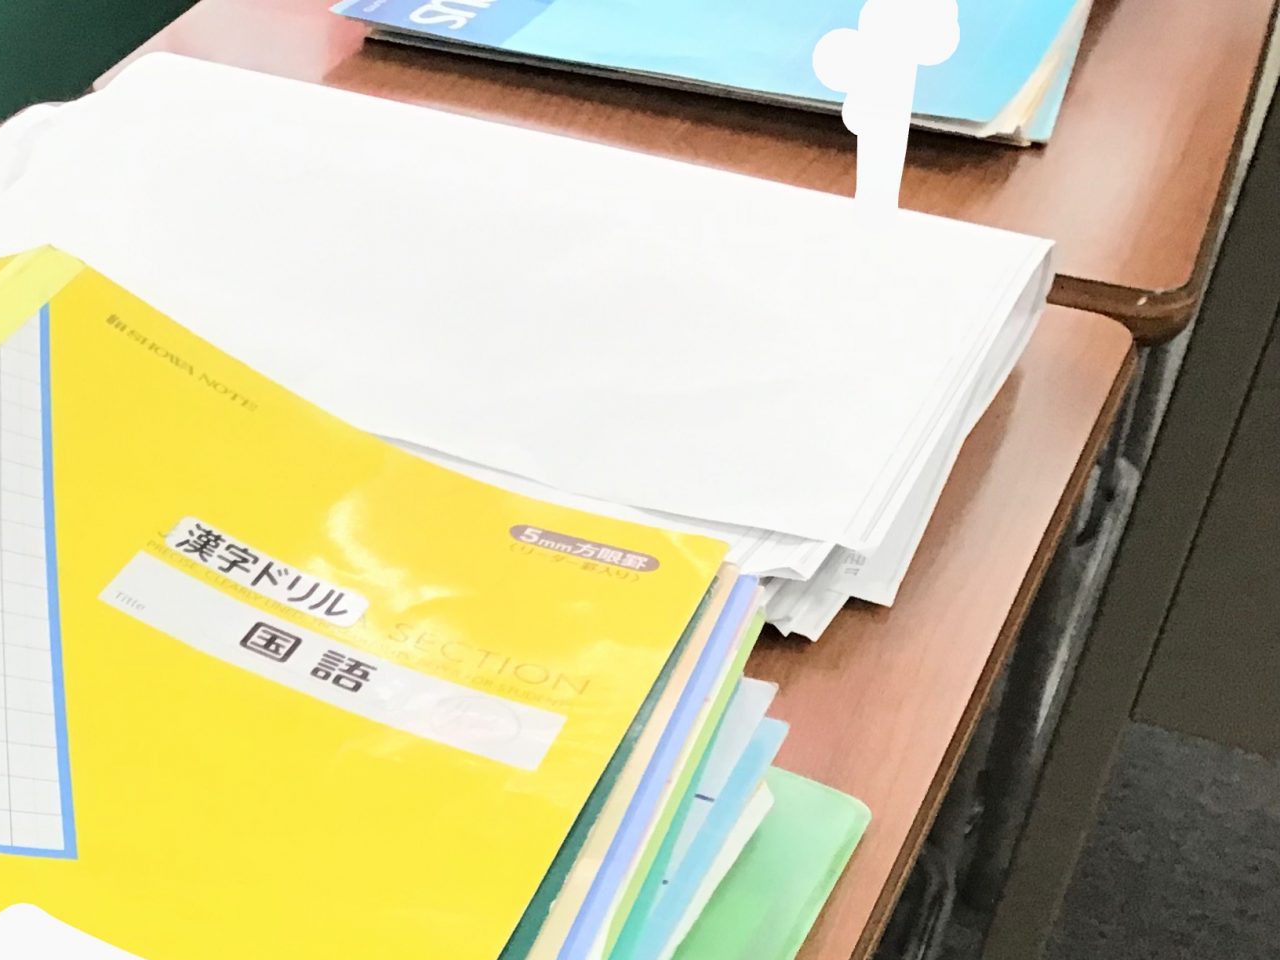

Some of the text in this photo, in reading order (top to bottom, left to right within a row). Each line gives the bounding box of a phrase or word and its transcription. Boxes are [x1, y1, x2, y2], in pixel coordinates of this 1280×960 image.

[175, 522, 349, 617] 漢字ドリル
[520, 526, 650, 571] 5mm方眼罫
[115, 591, 146, 612] Title
[239, 620, 378, 693] 国語
[387, 622, 592, 696] SECTION
